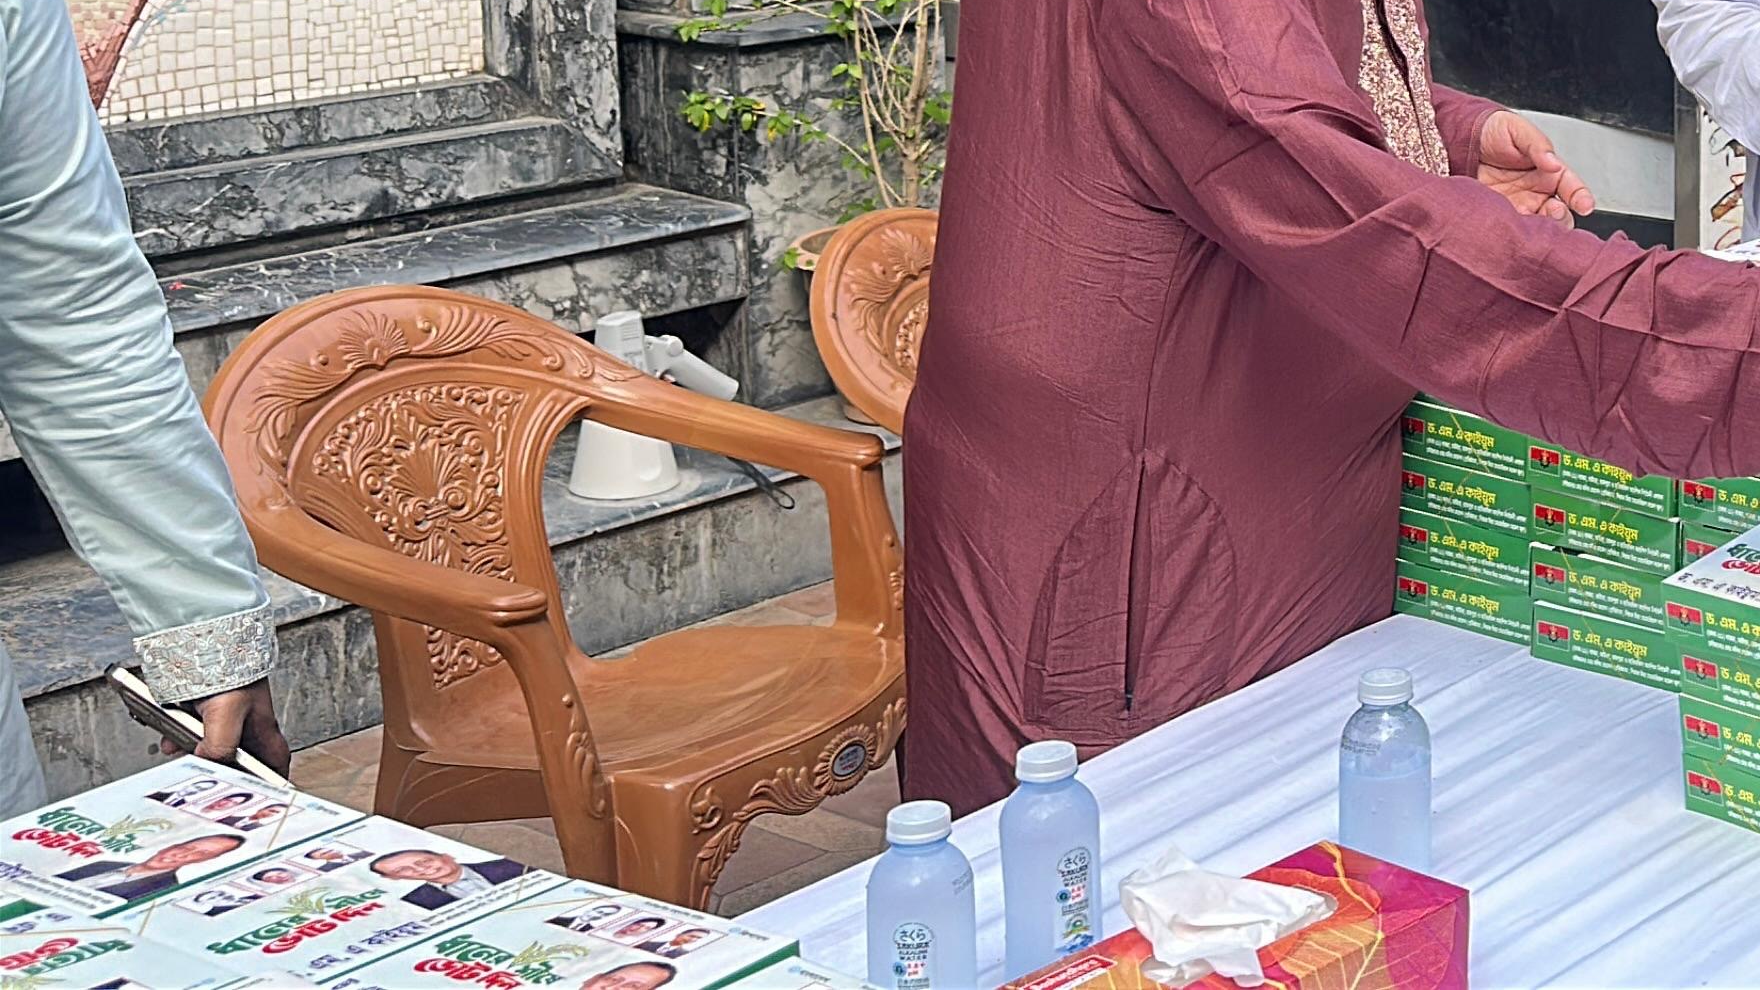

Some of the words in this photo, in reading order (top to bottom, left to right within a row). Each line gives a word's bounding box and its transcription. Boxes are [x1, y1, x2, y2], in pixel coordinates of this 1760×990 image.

[12, 828, 80, 849] ভোট
[1064, 852, 1087, 870] さくら
[205, 914, 309, 956] ধানের
[261, 919, 338, 955] ভোট
[330, 902, 386, 922] দিন
[899, 929, 926, 941] さくら
[434, 932, 512, 966] ধানের
[414, 958, 484, 980] ভোট
